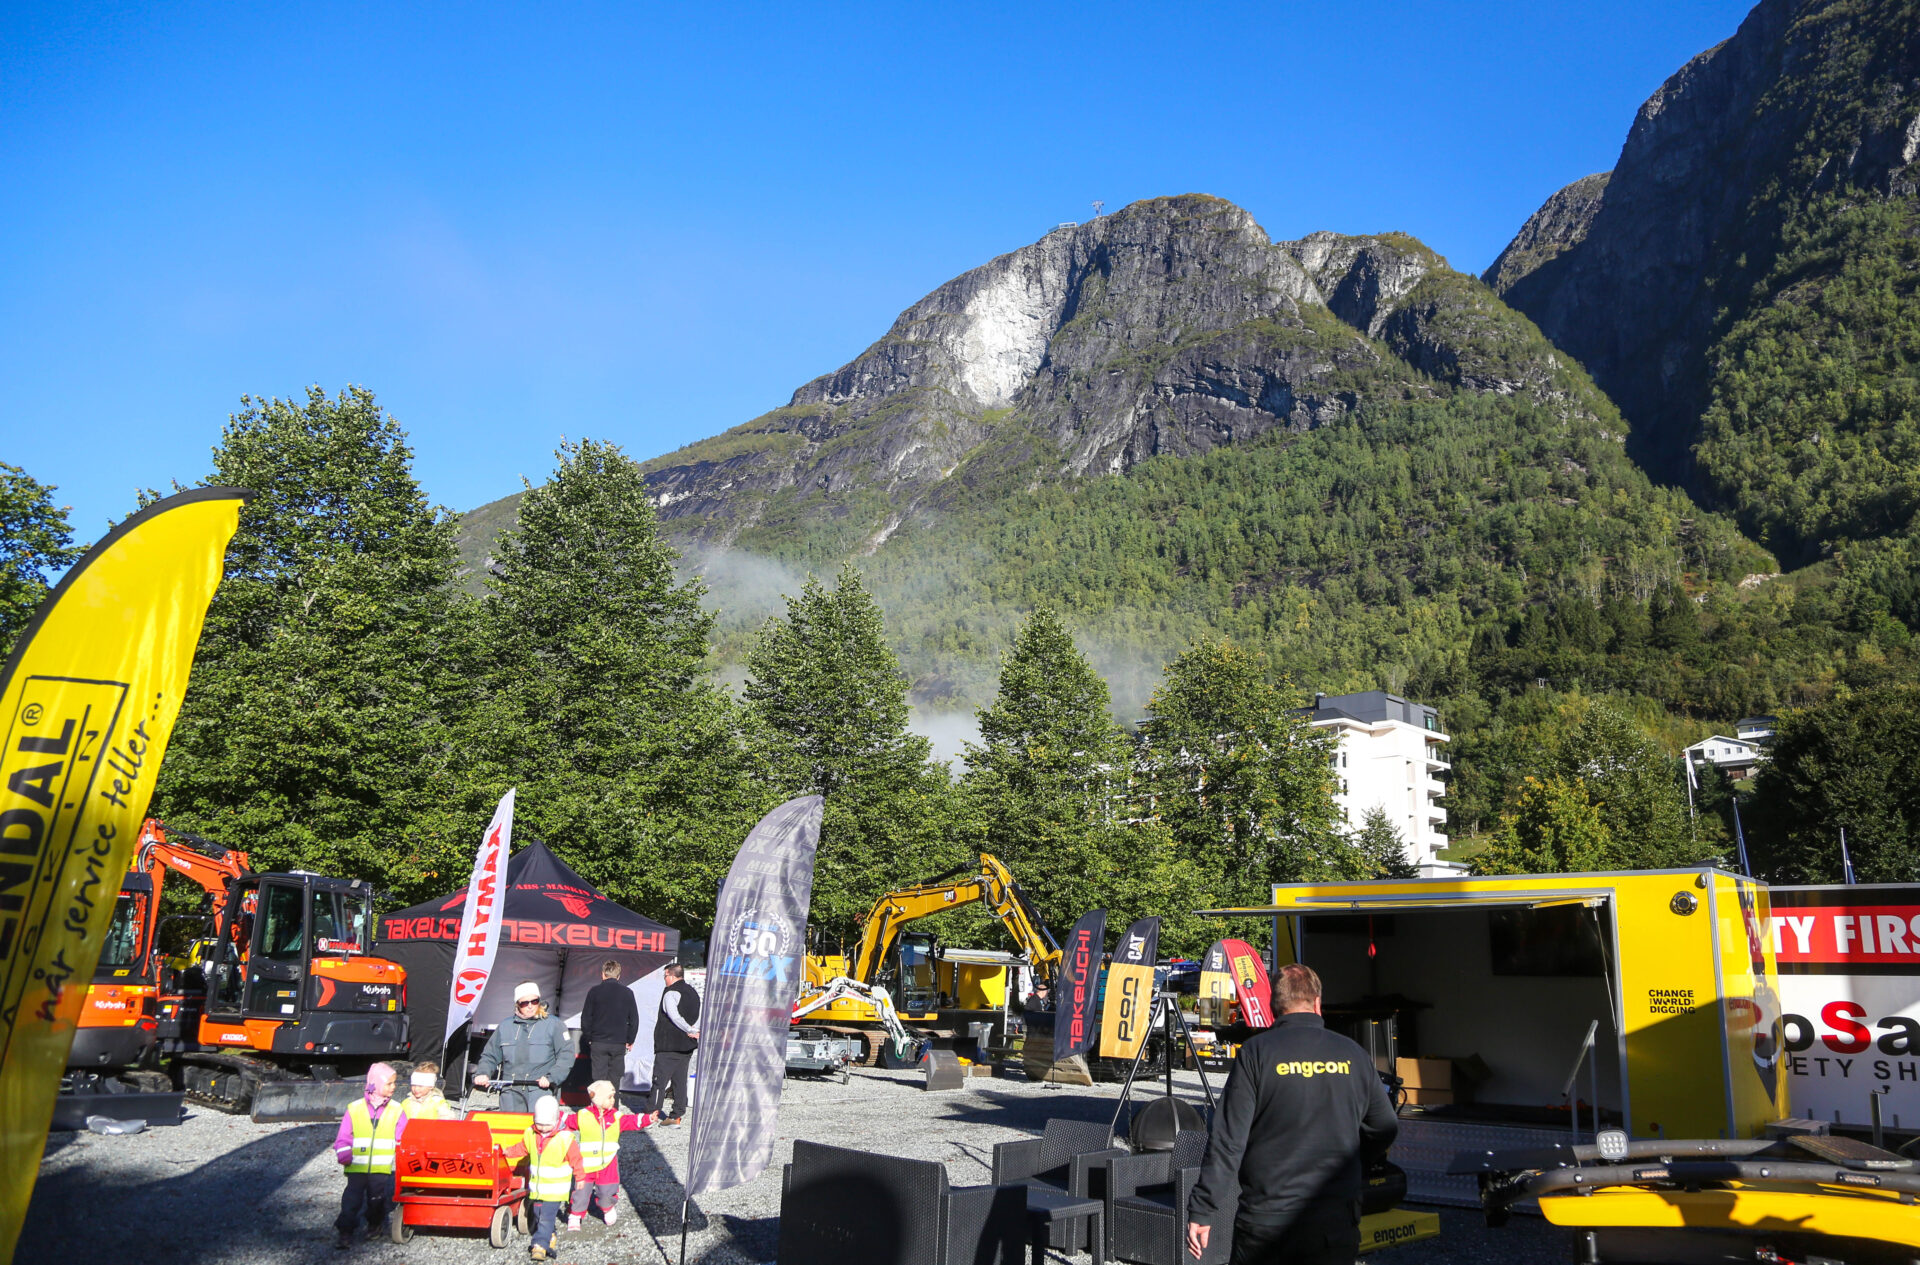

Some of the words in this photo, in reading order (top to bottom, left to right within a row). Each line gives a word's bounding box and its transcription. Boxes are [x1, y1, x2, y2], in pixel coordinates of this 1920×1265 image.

[466, 822, 502, 957] HYMAX
[944, 890, 954, 902] CAT
[35, 947, 75, 1022] når
[64, 821, 117, 940] service
[501, 920, 666, 953] TAKEUCHI
[1127, 932, 1145, 960] CAT
[1211, 950, 1223, 970] CAT
[362, 984, 391, 995] Kubota
[1070, 930, 1091, 1049] TAKEUCHI
[1648, 989, 1694, 998] CHANGE
[95, 1000, 126, 1010] Kubota
[1118, 977, 1134, 1042] pon
[1650, 1006, 1696, 1014] DIGGING
[1653, 998, 1691, 1006] WORLD
[1276, 1060, 1351, 1078] engcon
[1373, 1222, 1417, 1244] engcon
